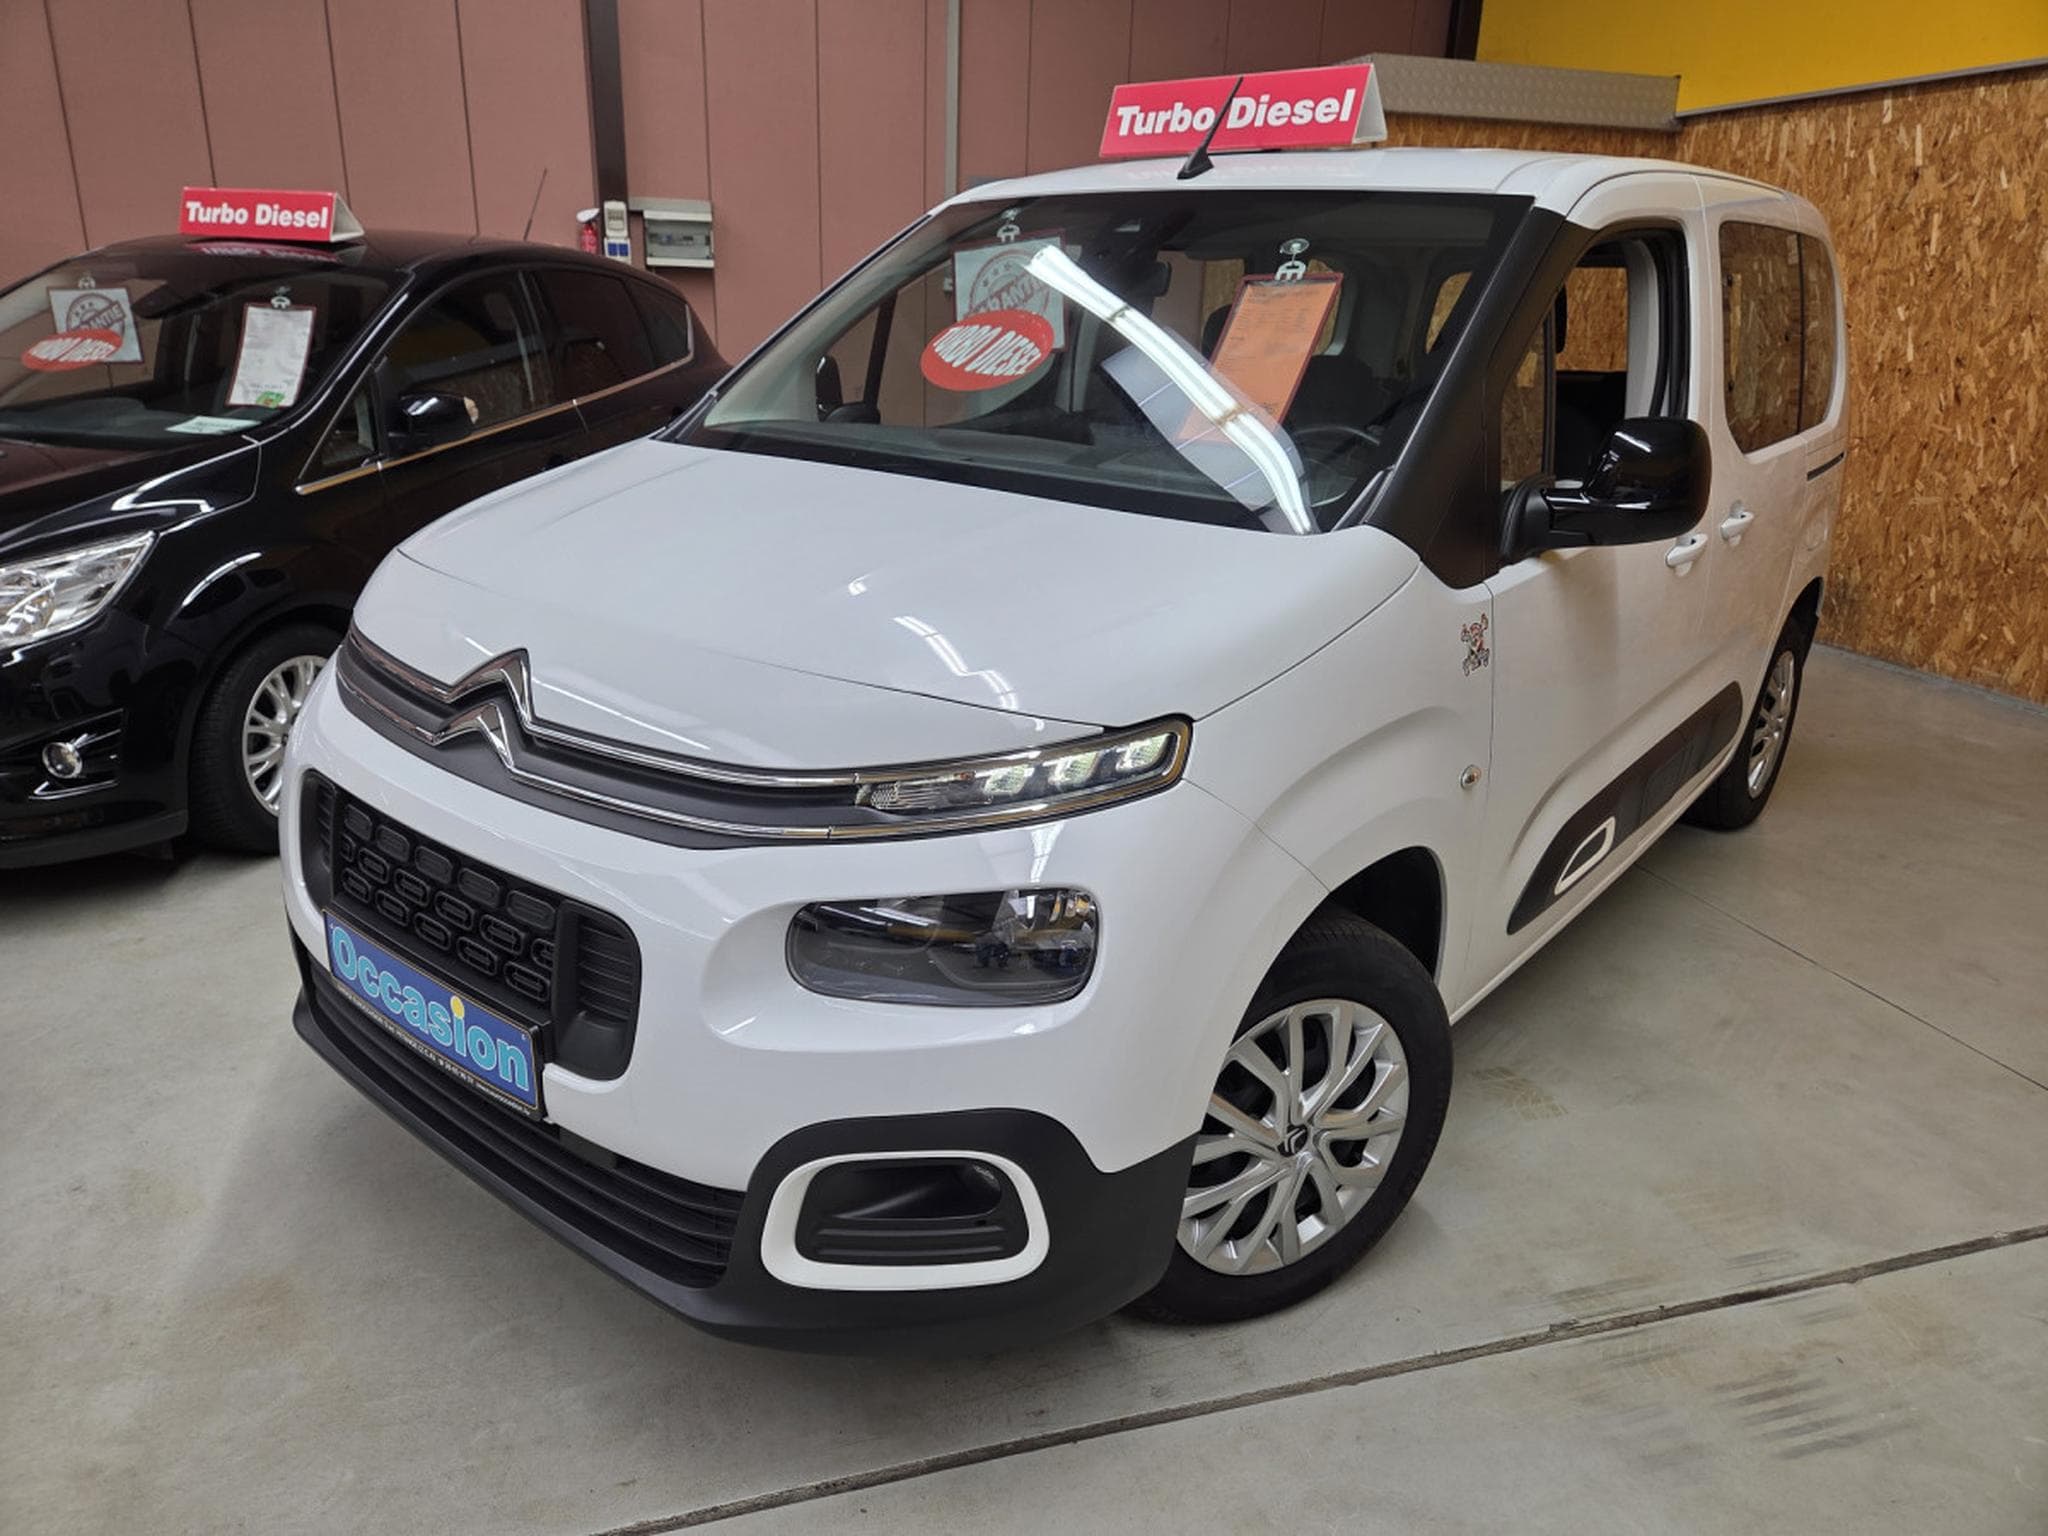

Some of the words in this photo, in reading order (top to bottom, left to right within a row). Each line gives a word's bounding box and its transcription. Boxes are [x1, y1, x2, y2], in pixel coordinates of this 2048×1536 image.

[1116, 101, 1217, 137] Turbo
[1227, 87, 1357, 130] Diesel
[185, 200, 249, 226] Turbo
[255, 203, 329, 229] Diesel
[964, 330, 1042, 377] DIESEL
[332, 925, 530, 1092] Occasion
